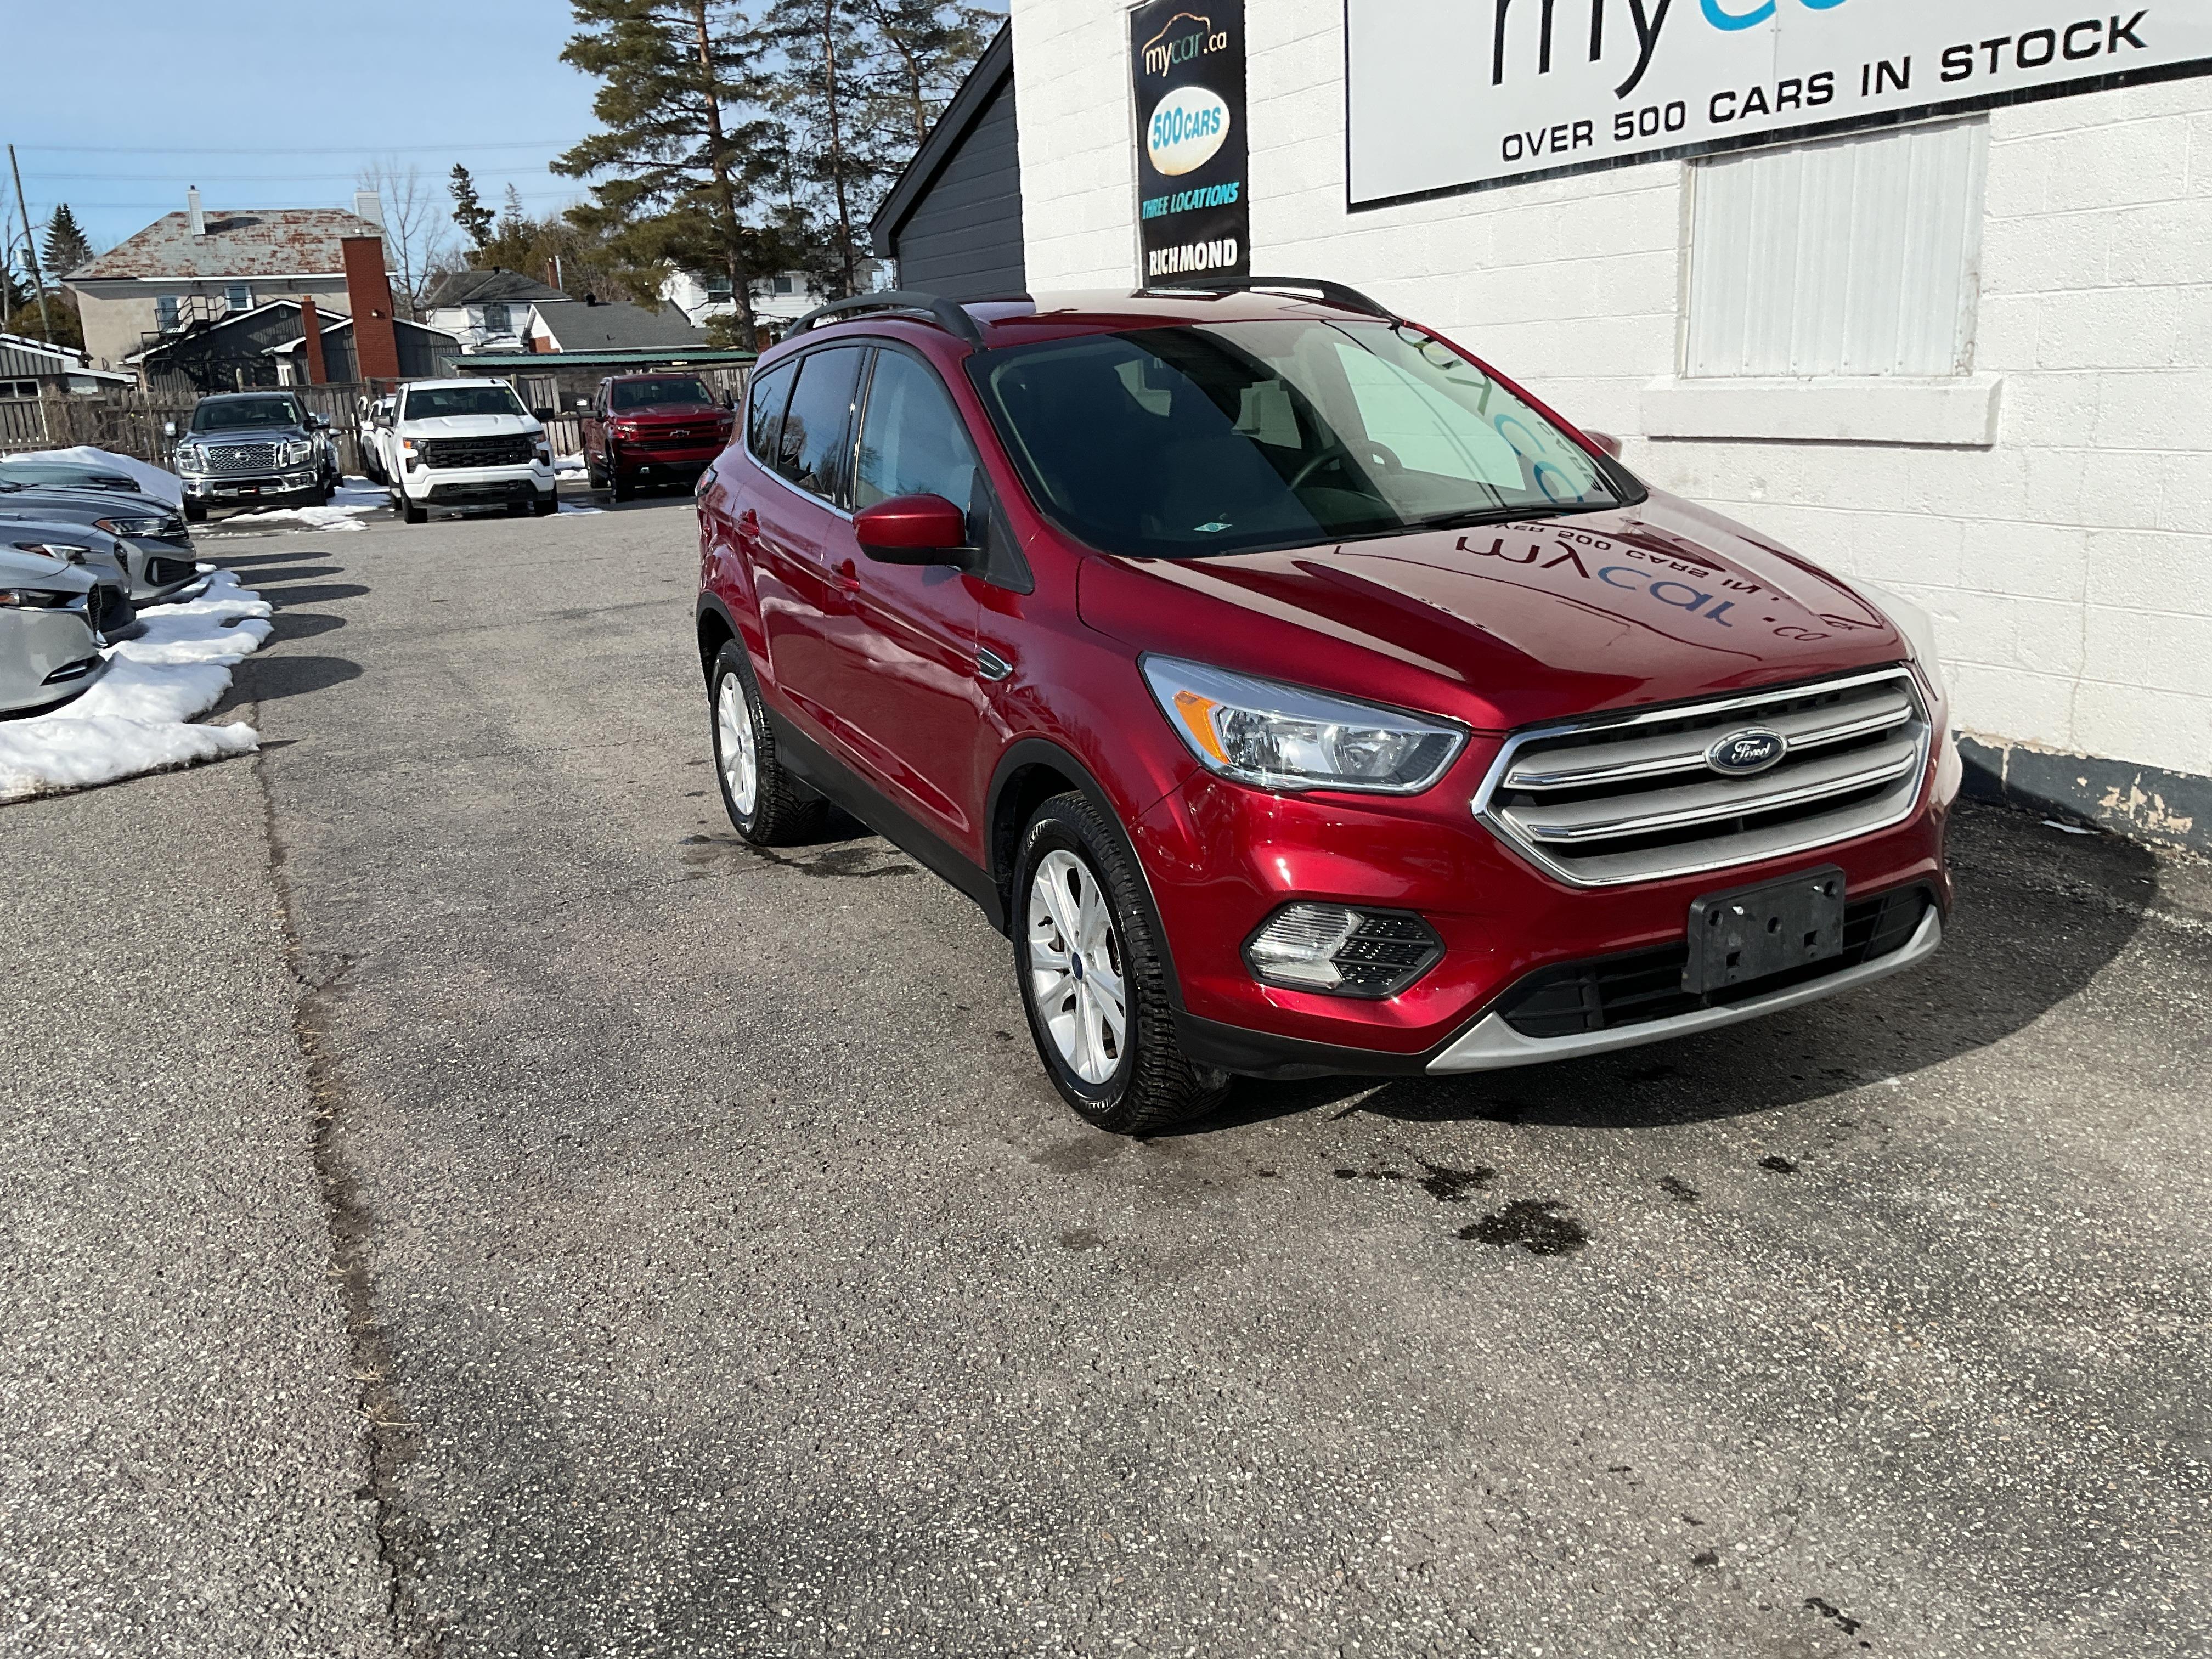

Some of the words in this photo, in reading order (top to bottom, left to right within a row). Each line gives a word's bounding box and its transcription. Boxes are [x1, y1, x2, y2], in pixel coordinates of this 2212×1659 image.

[1492, 0, 1847, 99] my
[1502, 120, 1593, 162] OVER
[1614, 100, 1686, 141] 500
[1709, 71, 1834, 123] CARS
[1861, 55, 1911, 96] IN
[1940, 9, 2150, 82] STOCK
[1142, 195, 1169, 219] THREE
[1171, 182, 1240, 213] LOCATIONS
[1149, 239, 1238, 276] RICHMOND
[1731, 740, 1770, 763] Ford
